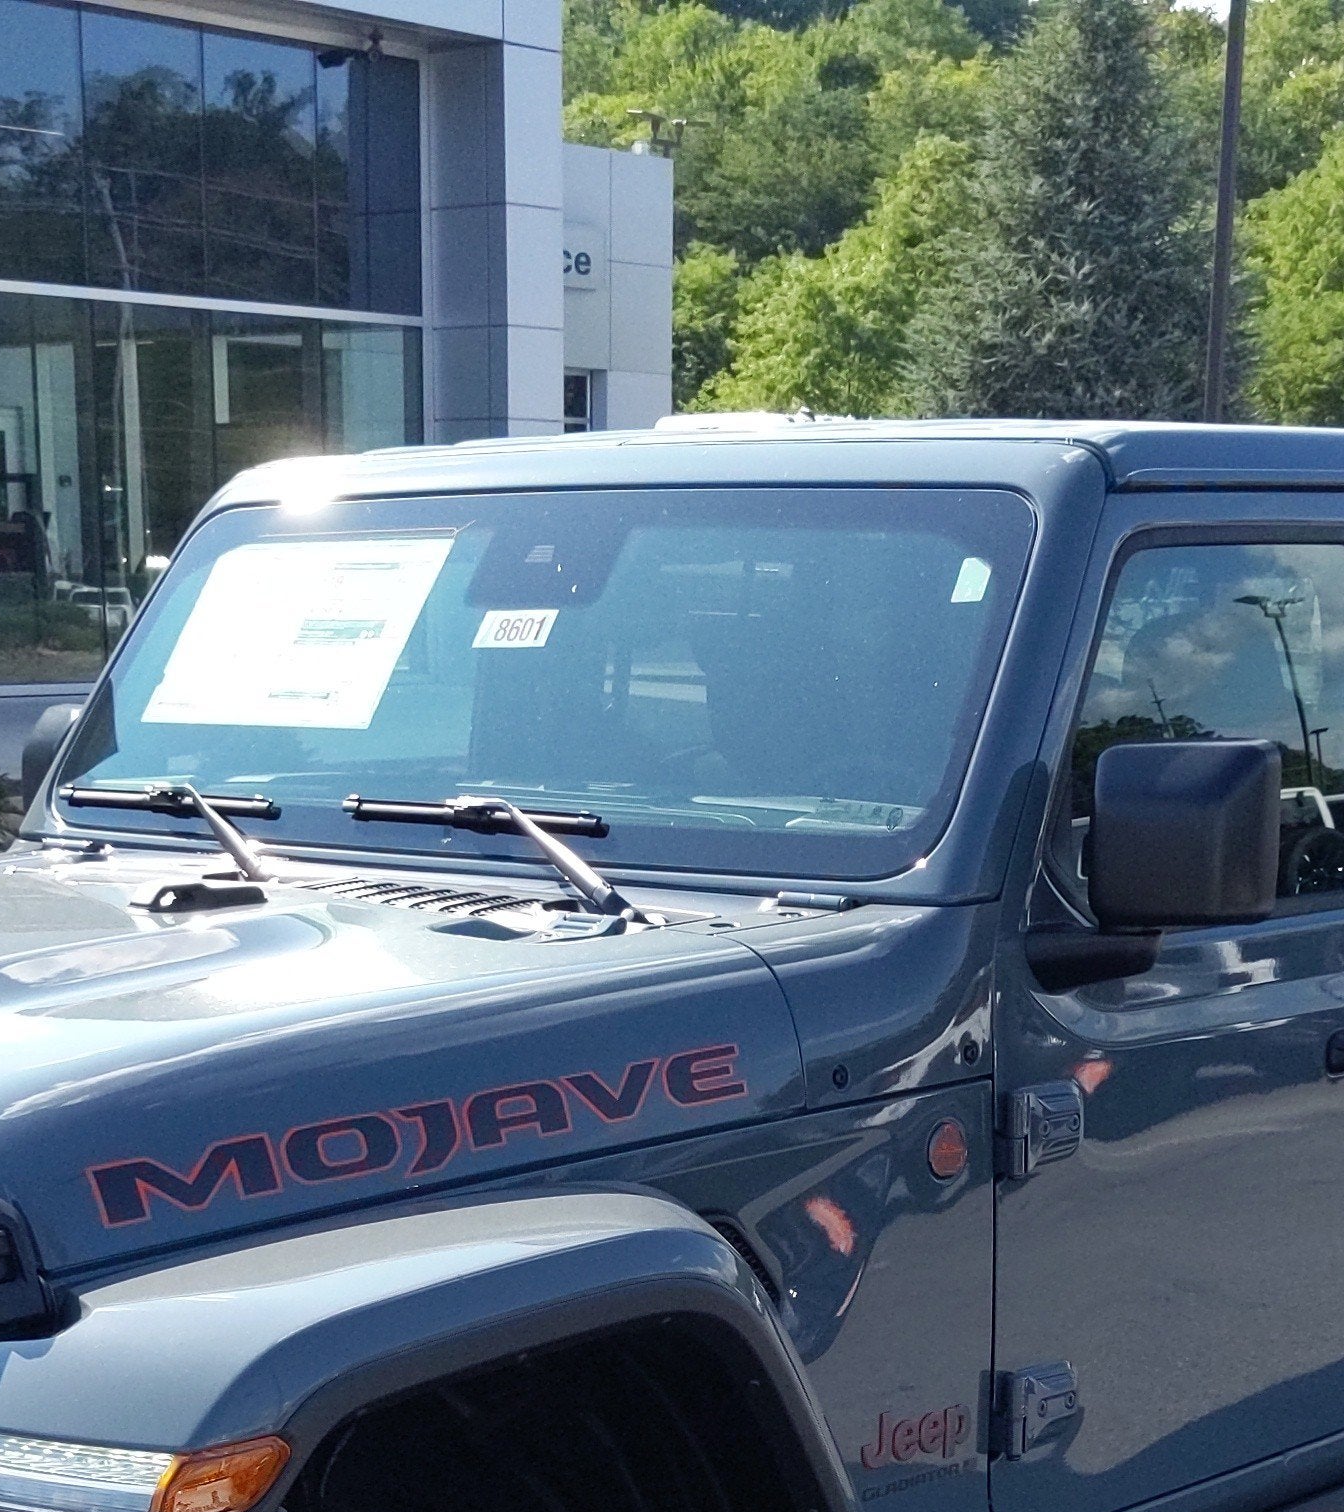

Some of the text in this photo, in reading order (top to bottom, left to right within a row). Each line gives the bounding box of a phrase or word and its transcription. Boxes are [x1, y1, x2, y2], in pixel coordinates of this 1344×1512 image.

[493, 616, 547, 642] 8601
[85, 1044, 748, 1229] MOJAVE
[860, 1403, 973, 1471] Jeep
